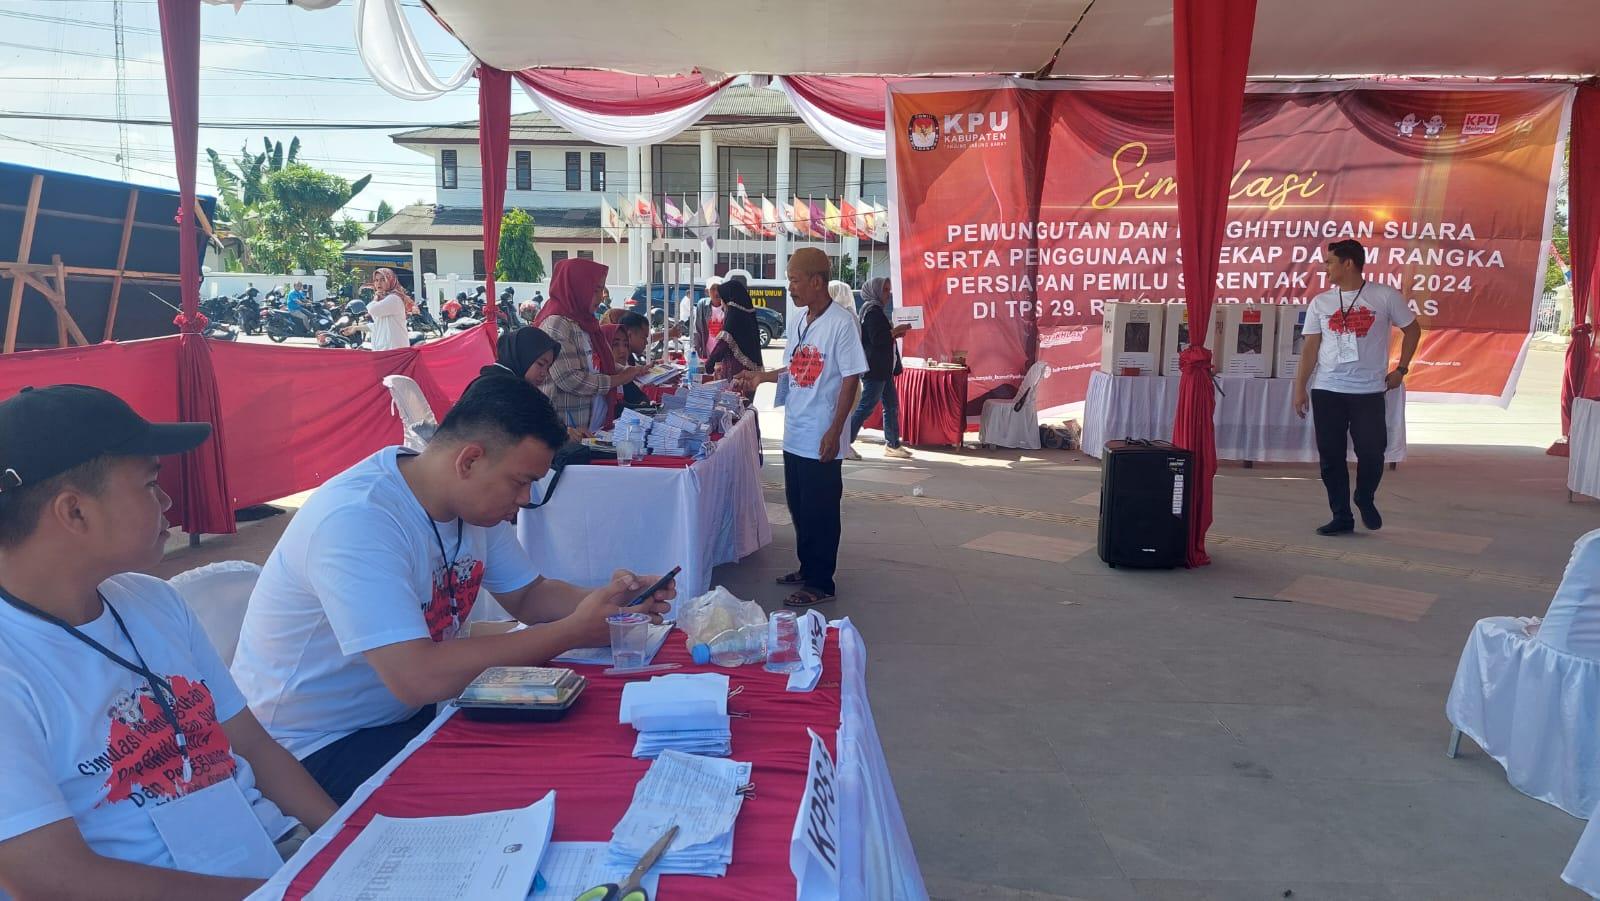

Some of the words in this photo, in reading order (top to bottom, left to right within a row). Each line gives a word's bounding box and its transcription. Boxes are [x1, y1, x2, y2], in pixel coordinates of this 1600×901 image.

[944, 111, 1009, 134] KPU
[1466, 115, 1497, 127] KPU
[944, 132, 1007, 143] KABUPATEN
[1091, 141, 1325, 210] Simlasi
[947, 221, 1111, 242] PEMUNGUTAN
[1118, 221, 1168, 239] DAN
[1176, 220, 1374, 239] GHITUNGAN
[1383, 221, 1476, 241] SUARA
[923, 249, 1001, 269] SERTA
[1009, 247, 1167, 266] PENGGUNAAN
[1175, 246, 1283, 264] SEKAP
[1291, 246, 1379, 265] DAM
[1388, 247, 1505, 268] RANGKA
[946, 273, 1074, 295] PERSIAPAN
[1083, 272, 1168, 291] PEMILU
[1177, 271, 1308, 289] SRENTAK
[1411, 273, 1472, 293] 2024
[973, 301, 996, 320] DI
[1004, 299, 1043, 318] TPS
[1049, 299, 1082, 316] 29.
[77, 733, 142, 777] Simulasi
[127, 781, 165, 808] Dan
[808, 759, 836, 871] KPPS
